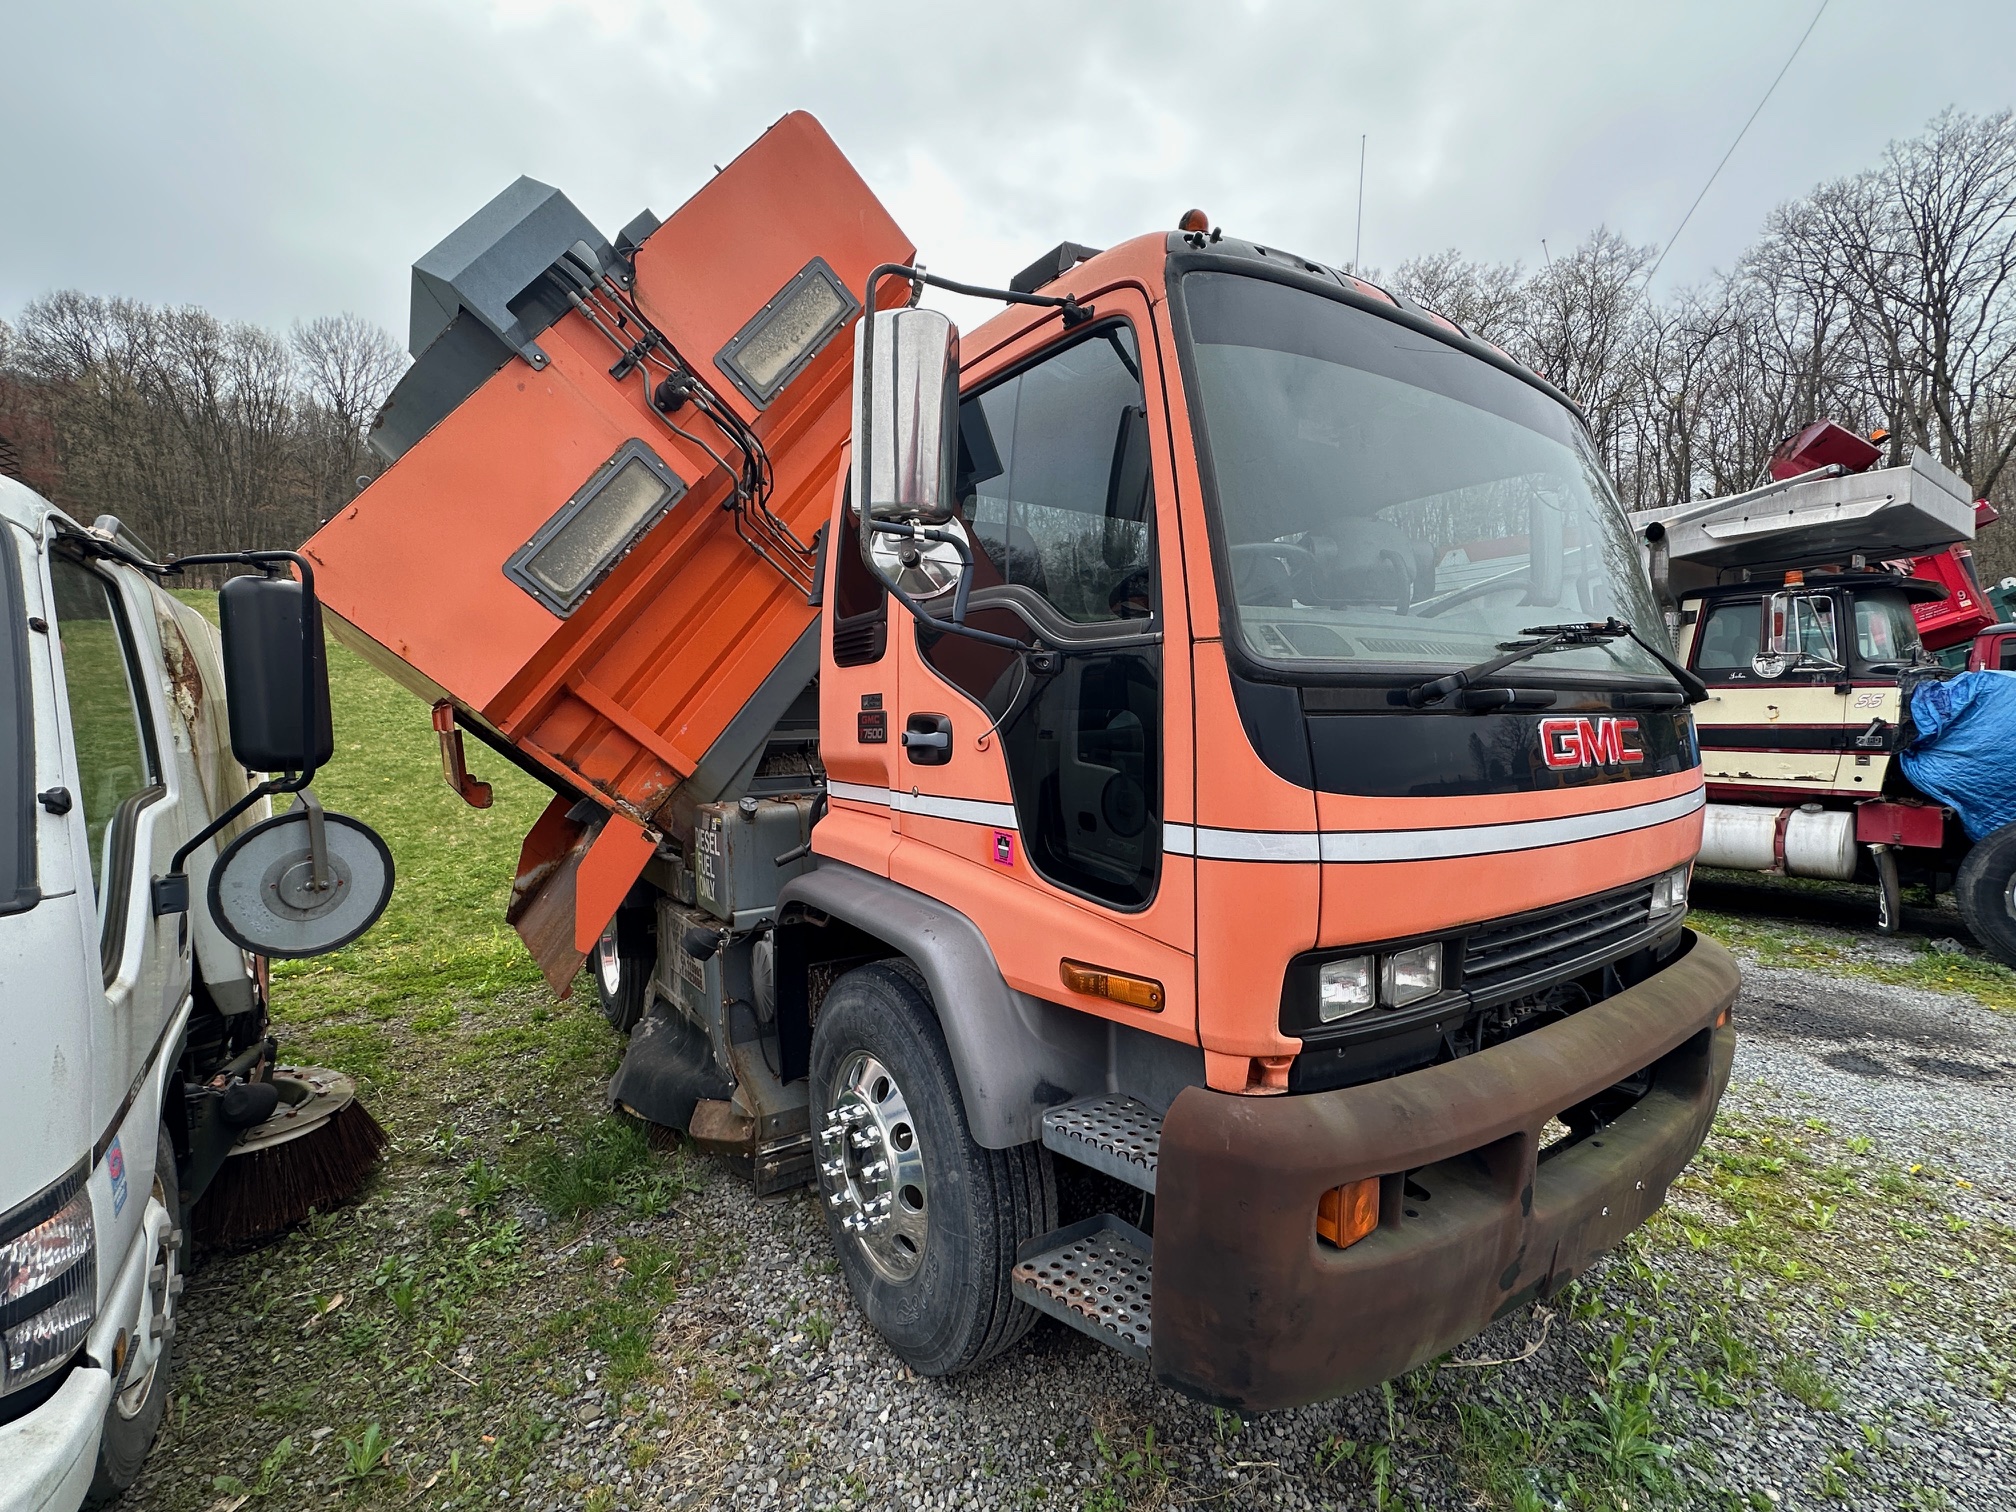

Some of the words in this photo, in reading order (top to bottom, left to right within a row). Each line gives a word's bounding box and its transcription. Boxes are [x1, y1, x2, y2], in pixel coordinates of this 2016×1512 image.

[1957, 590, 1967, 600] 9
[861, 715, 880, 724] GMC
[1538, 717, 1643, 769] GMC
[697, 851, 716, 879] FUEL
[699, 874, 716, 902] ONLY
